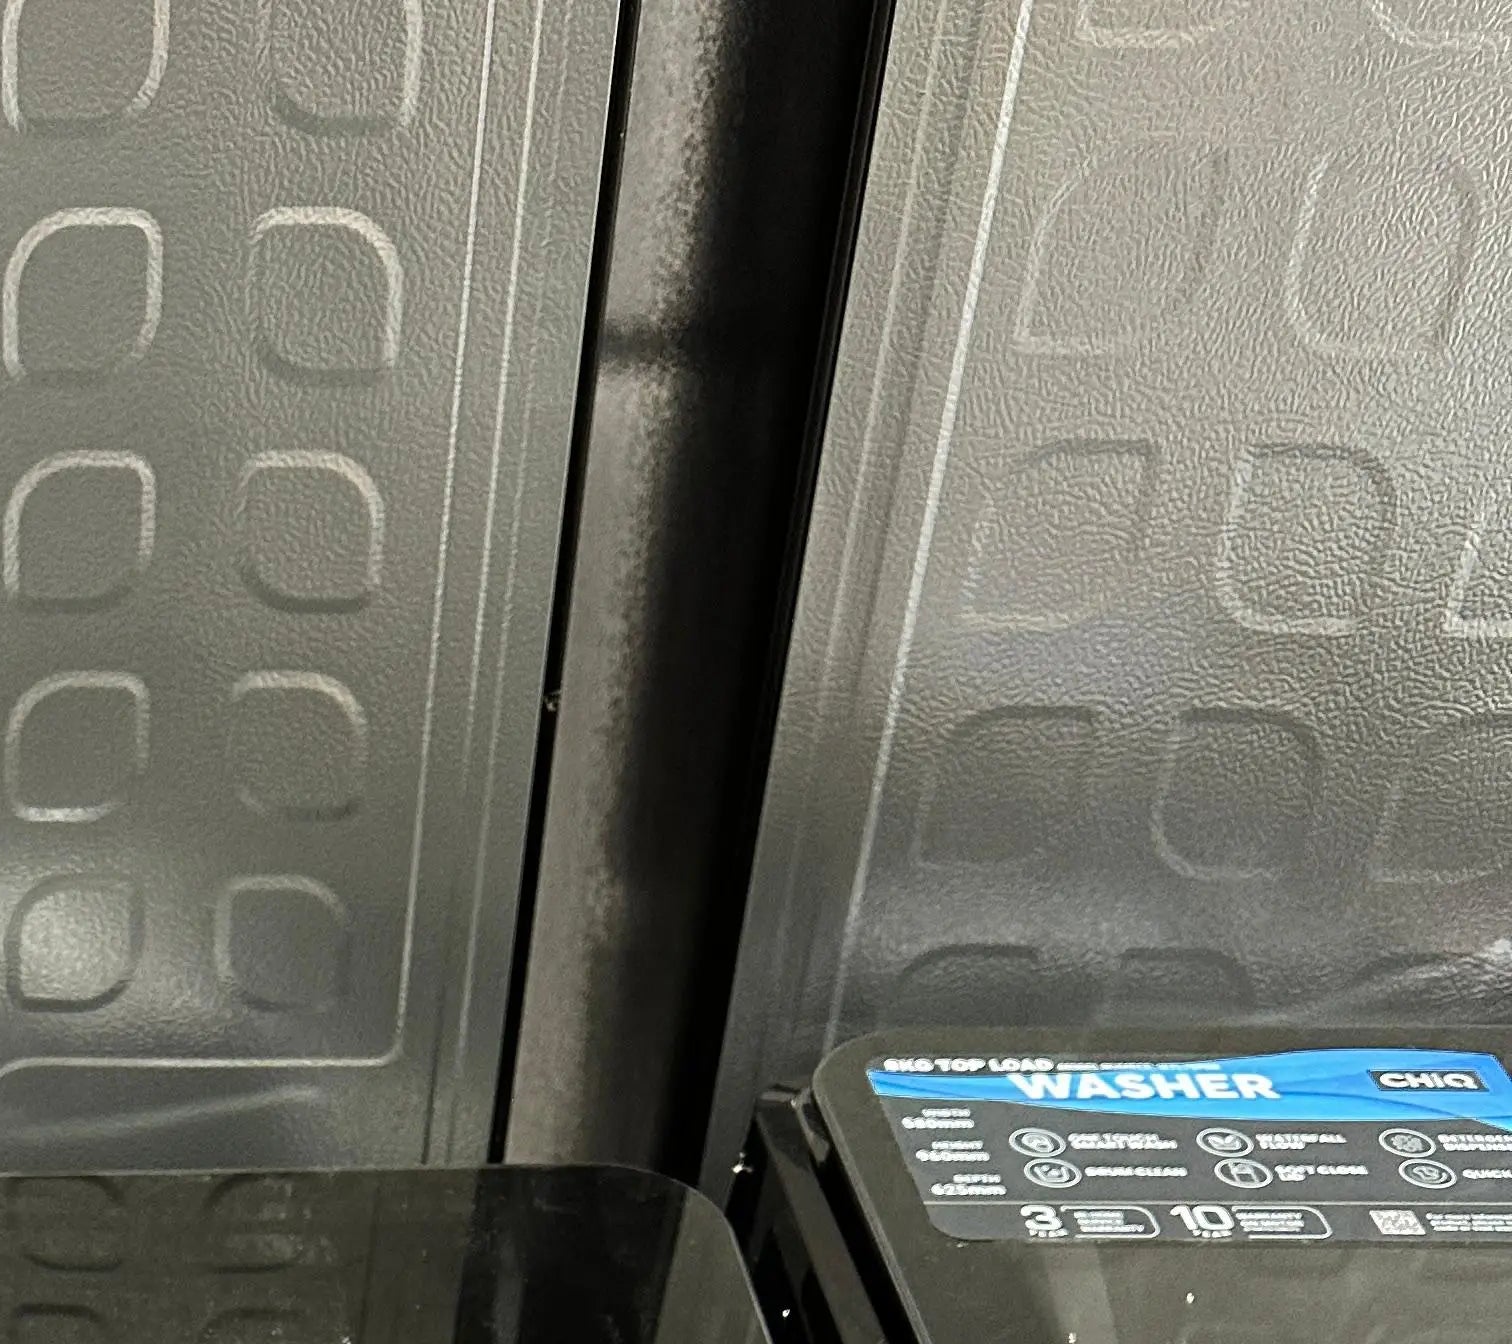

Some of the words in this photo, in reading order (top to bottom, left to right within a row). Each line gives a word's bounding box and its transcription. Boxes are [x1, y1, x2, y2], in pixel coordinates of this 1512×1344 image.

[934, 1058, 986, 1072] TOP
[988, 1058, 1054, 1072] LOAD
[1007, 1072, 1281, 1100] WASHER
[1020, 1204, 1063, 1231] 3
[1171, 1204, 1235, 1231] 10
